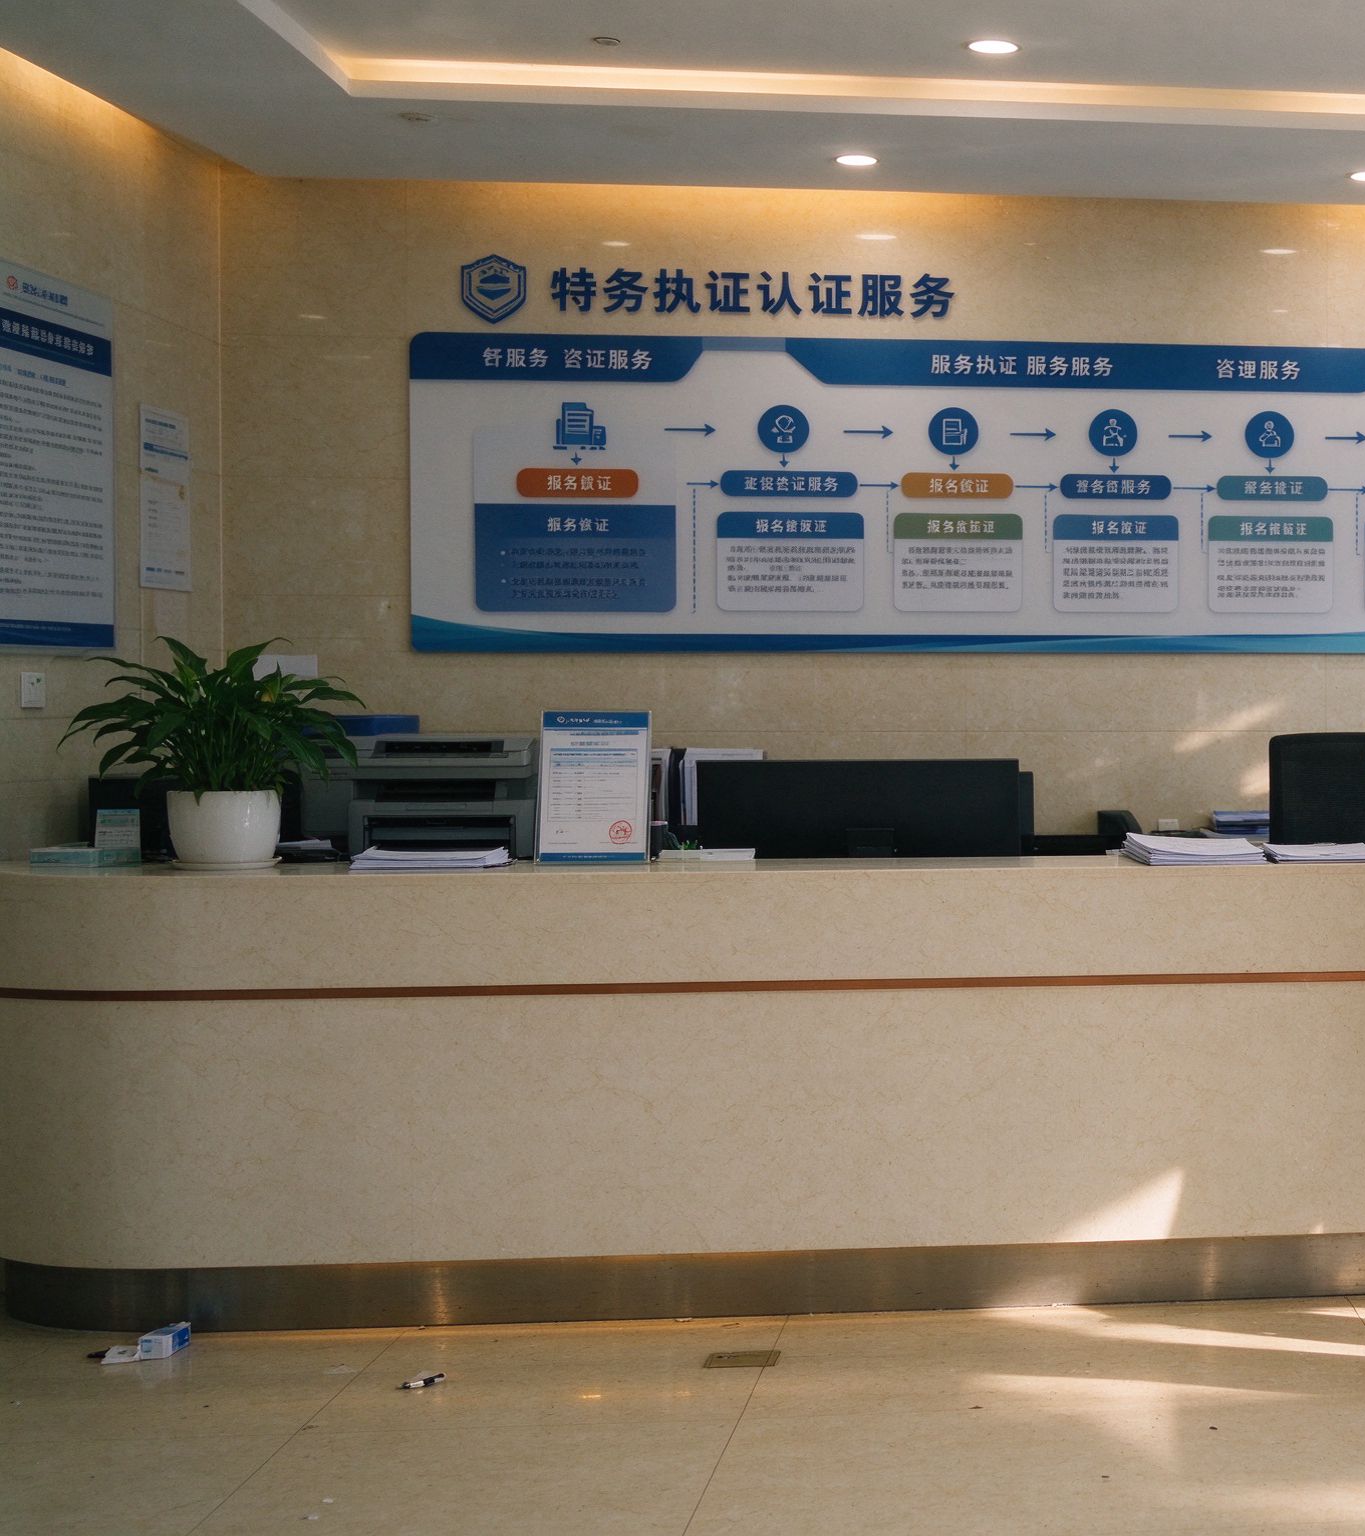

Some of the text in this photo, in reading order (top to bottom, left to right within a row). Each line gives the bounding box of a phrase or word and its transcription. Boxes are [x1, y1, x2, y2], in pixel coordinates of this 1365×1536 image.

[550, 267, 955, 318] 特务执证认证服务
[931, 353, 1113, 377] 服务执证 服务服务
